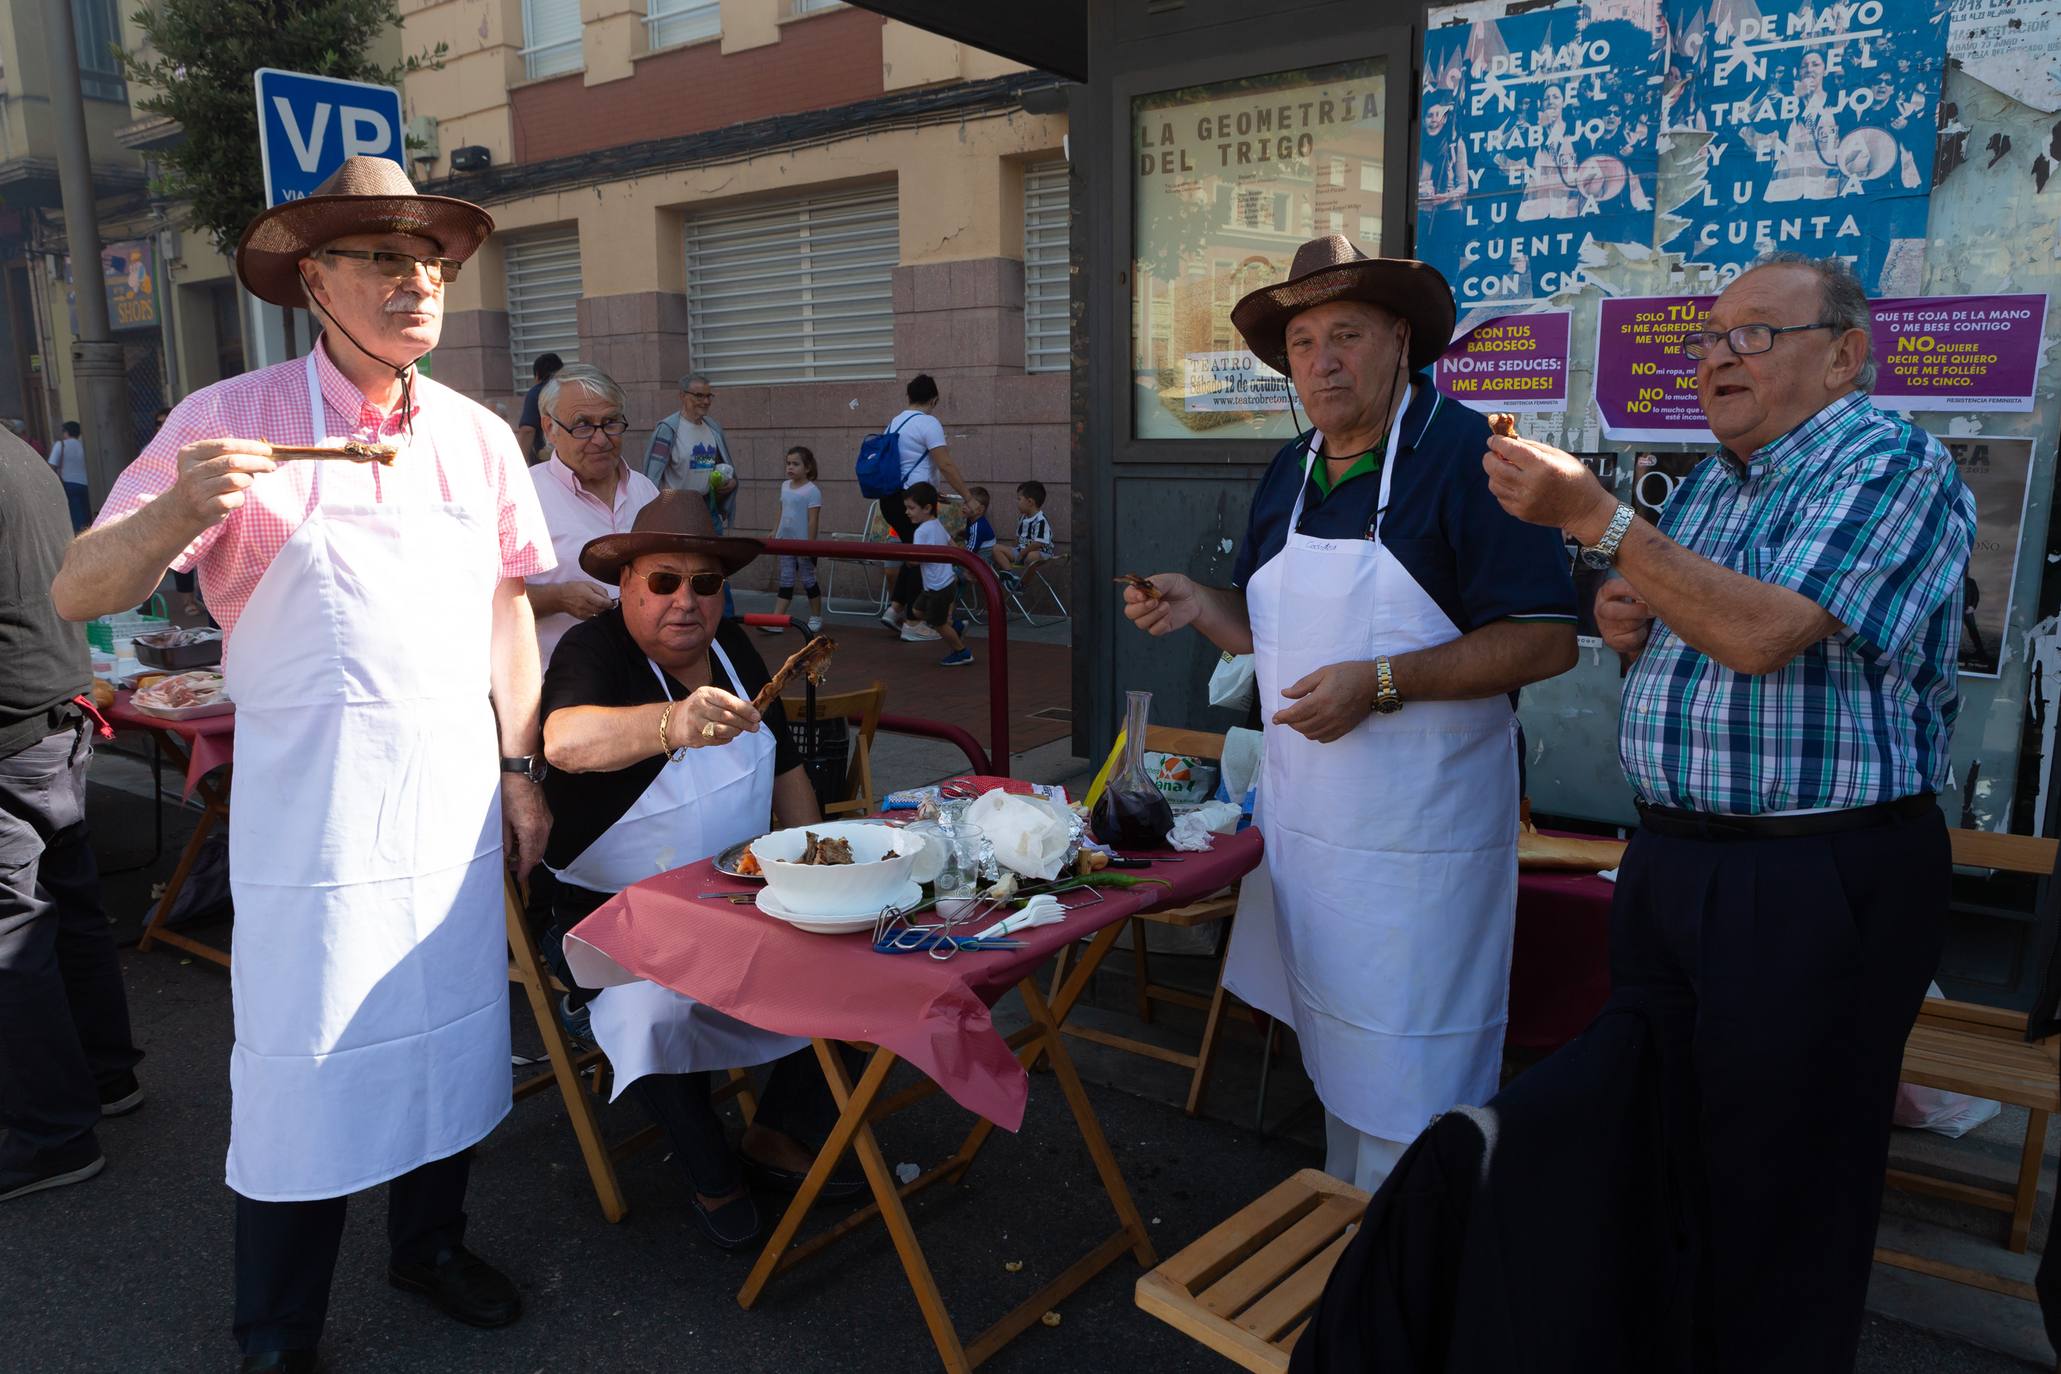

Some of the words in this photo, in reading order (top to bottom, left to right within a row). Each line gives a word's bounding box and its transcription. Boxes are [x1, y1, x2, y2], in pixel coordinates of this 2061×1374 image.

[1740, 14, 1778, 43] DE
[1786, 0, 1883, 36] MAYO
[1492, 52, 1524, 75] DE
[1530, 39, 1611, 71] MAYO
[1714, 57, 1768, 87] EN
[1827, 45, 1878, 74] EL
[1471, 90, 1516, 116] EN
[1564, 78, 1608, 107] EL
[1710, 87, 1874, 127] TRABAJO
[1141, 122, 1175, 148] LA
[1197, 90, 1379, 142] GEOMETRÍA
[272, 96, 392, 174] VP
[1469, 118, 1605, 153] TRABAJO
[1141, 149, 1193, 176] DEL
[1217, 132, 1314, 167] TRIGO
[1707, 143, 1729, 166] Y
[1755, 139, 1791, 162] EN
[1468, 168, 1486, 190] Y
[1508, 163, 1539, 186] EN
[282, 188, 305, 201] VIA
[1703, 173, 1865, 207] LUA
[1466, 194, 1601, 226] LUA
[1700, 214, 1861, 246] CUENTA
[1464, 232, 1601, 261] CUENTA
[1463, 275, 1519, 297] CON
[119, 299, 154, 324] SHOPS
[1636, 313, 1665, 321] SOLO
[1668, 301, 1696, 321] TÚ
[1875, 312, 1899, 321] QUE
[1902, 312, 1914, 321] TE
[1917, 312, 1948, 321] COJA
[1952, 311, 1967, 320] DE
[1970, 311, 1985, 320] LA
[1989, 310, 2031, 319] MANO
[1473, 328, 1503, 339] CON
[1506, 326, 1531, 337] TUS
[1621, 325, 1631, 333] SI
[1633, 324, 1650, 333] ME
[1890, 324, 1900, 332] O
[1903, 323, 1920, 332] ME
[1923, 323, 1950, 331] BESE
[1953, 322, 2011, 331] CONTIGO
[1467, 339, 1537, 352] BABOSEOS
[1635, 335, 1652, 344] ME
[1897, 336, 1935, 352] NO
[1936, 343, 1979, 352] QUIERE
[1663, 345, 1681, 354] ME
[1190, 357, 1252, 372] TEATRO
[1442, 357, 1475, 373] NO
[1475, 360, 1495, 372] ME
[1498, 359, 1562, 371] SEDUCES:
[1887, 355, 1919, 364] DECIR
[1923, 355, 1947, 364] QUE
[1951, 354, 1997, 364] QUIERO
[1632, 363, 1657, 375] NO
[1894, 366, 1918, 375] QUE
[1922, 366, 1939, 375] ME
[1942, 364, 1987, 375] FOLLÉIS
[1225, 375, 1235, 393] 12
[1237, 373, 1248, 392] de
[1452, 379, 1478, 392] ¡ME
[1482, 377, 1553, 391] AGREDES!
[1907, 377, 1929, 386] LOS
[1932, 377, 1974, 387] CINCO.
[1639, 388, 1664, 400] NO
[1665, 393, 1672, 401] lo
[1673, 393, 1698, 401] mucho
[1627, 401, 1652, 413] NO
[1686, 407, 1700, 415] que
[1665, 413, 1681, 421] esté
